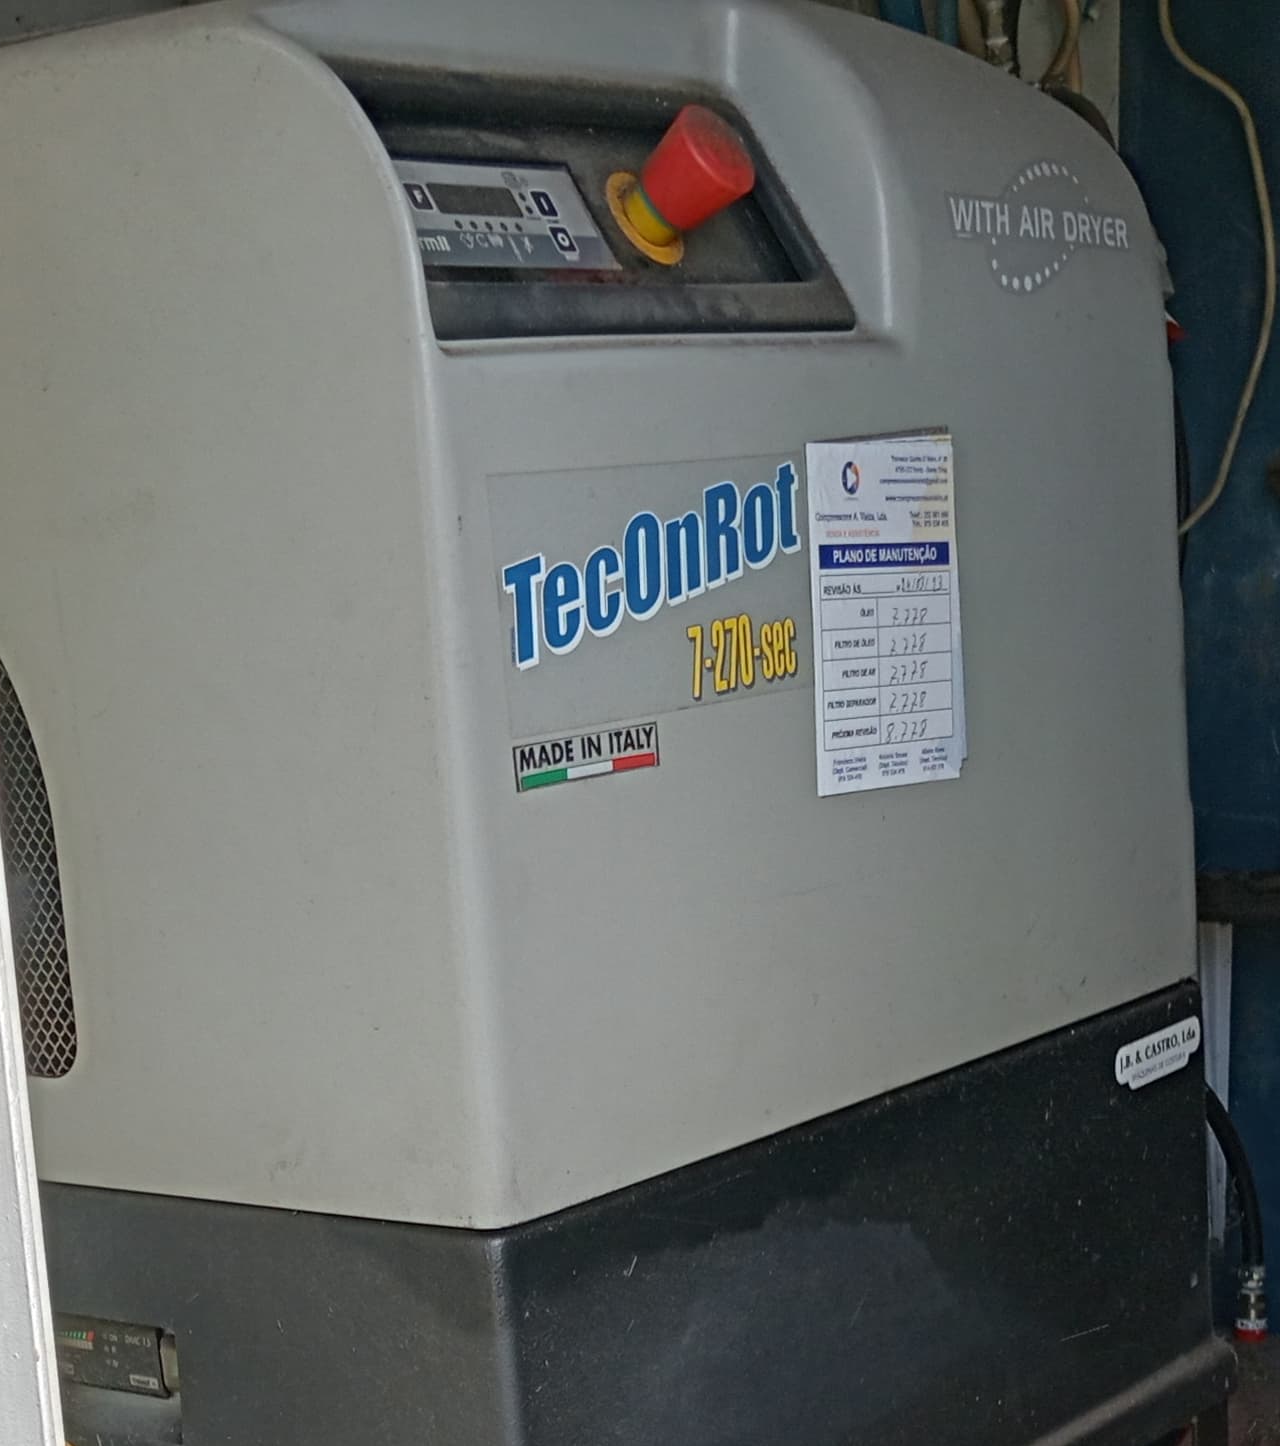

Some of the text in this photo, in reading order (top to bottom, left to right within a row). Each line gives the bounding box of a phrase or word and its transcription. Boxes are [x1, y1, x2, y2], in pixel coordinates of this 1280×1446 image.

[949, 197, 1129, 248] WITH AIR DRYER
[502, 460, 801, 671] TecOnRot
[833, 545, 937, 563] PLANO DE MANUTENÇÃO
[687, 614, 798, 701] 7-270-sec
[519, 726, 654, 772] MADE IN ITALY
